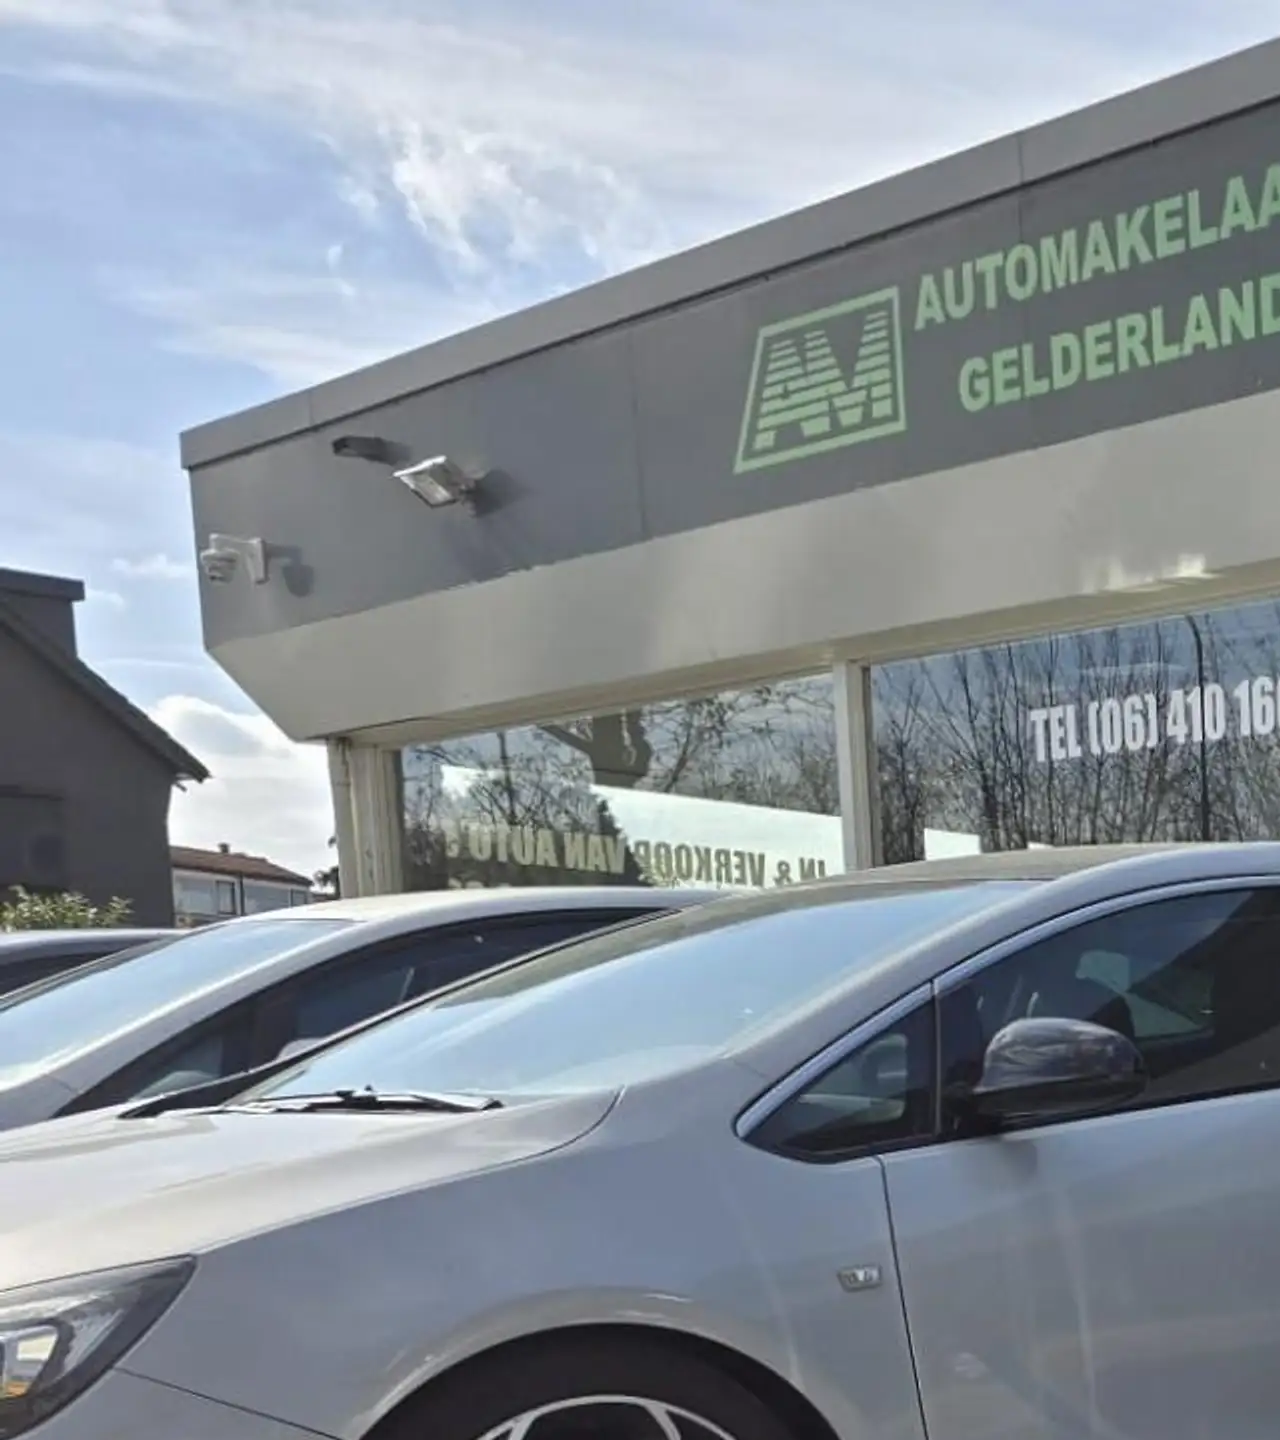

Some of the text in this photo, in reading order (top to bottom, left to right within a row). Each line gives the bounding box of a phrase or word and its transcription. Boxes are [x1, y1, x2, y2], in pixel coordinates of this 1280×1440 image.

[1029, 705, 1082, 762] TEL
[1089, 693, 1158, 756] (06)
[1166, 684, 1226, 744] 410
